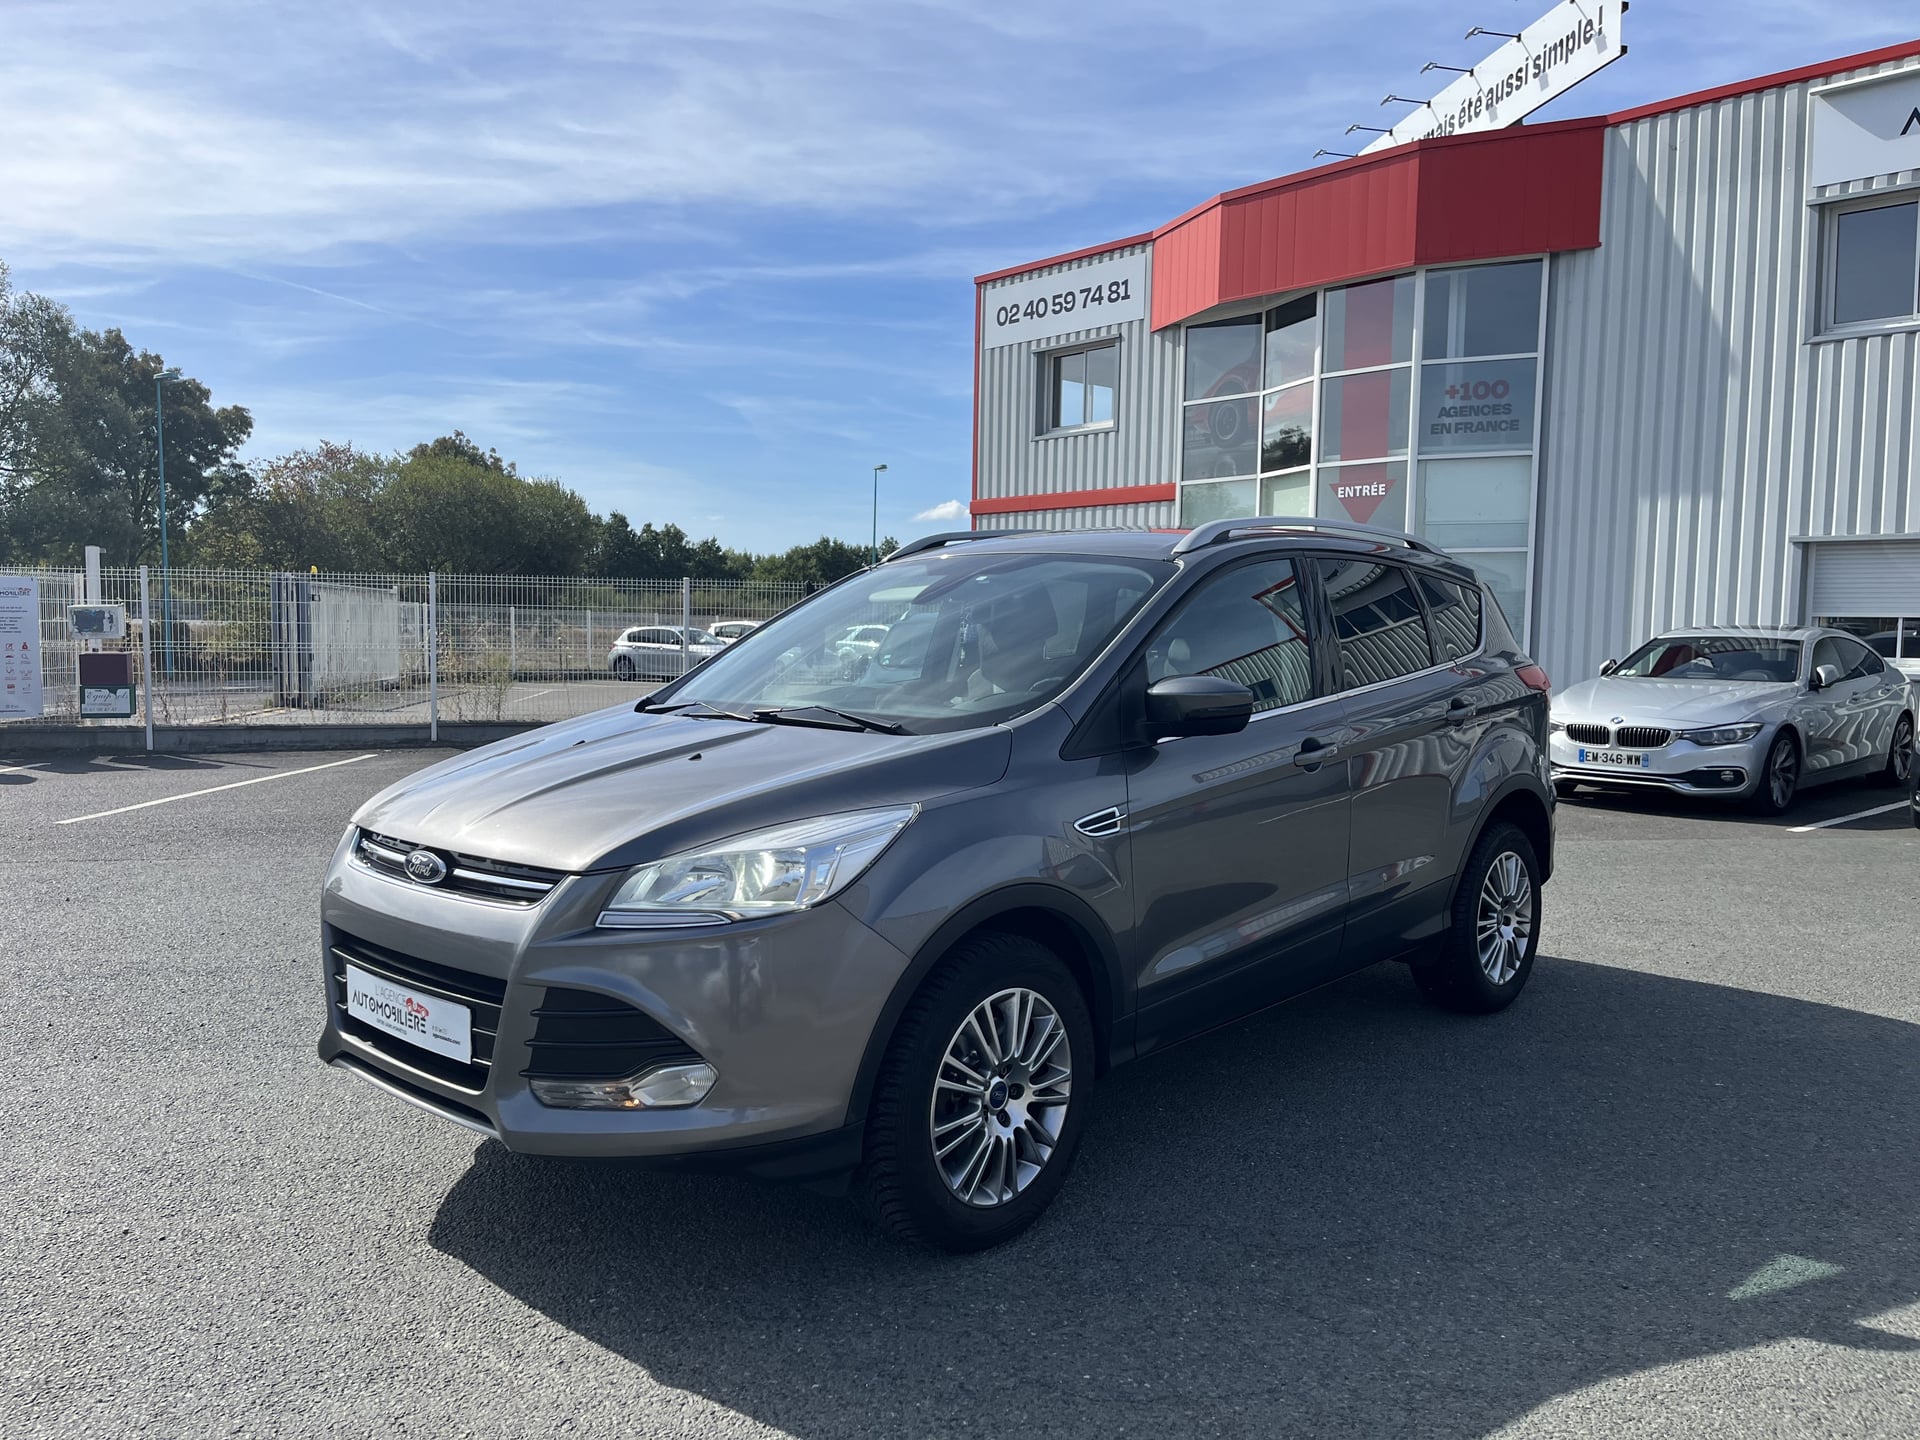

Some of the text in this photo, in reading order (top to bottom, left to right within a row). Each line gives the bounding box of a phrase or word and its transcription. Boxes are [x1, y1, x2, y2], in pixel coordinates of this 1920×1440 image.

[1458, 87, 1483, 129] été
[1485, 56, 1530, 111] aussi
[1532, 18, 1594, 79] simple
[996, 279, 1131, 327] 02 40 59 74 81
[1444, 379, 1510, 402] +100
[1437, 403, 1513, 419] AGENCES
[1430, 419, 1520, 436] EN FRANCE
[1337, 481, 1386, 499] ENTRÉE
